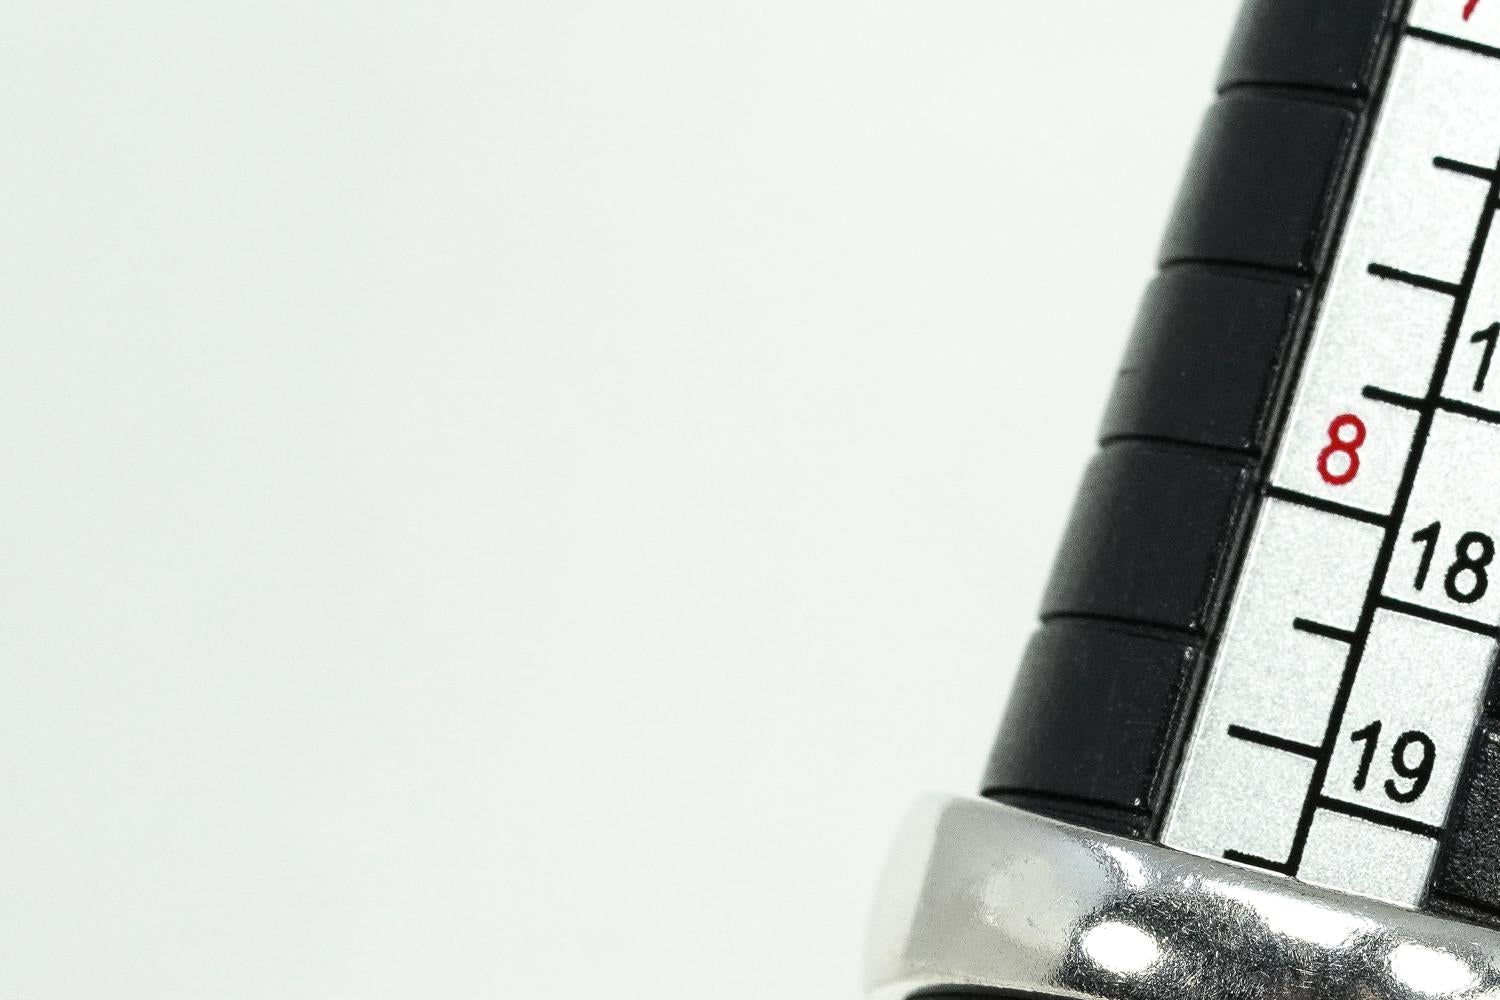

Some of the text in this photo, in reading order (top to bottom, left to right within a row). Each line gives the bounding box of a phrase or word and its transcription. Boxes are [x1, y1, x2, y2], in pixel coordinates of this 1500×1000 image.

[1317, 413, 1367, 486] 8
[1411, 520, 1495, 604] 18
[1350, 719, 1436, 804] 19
